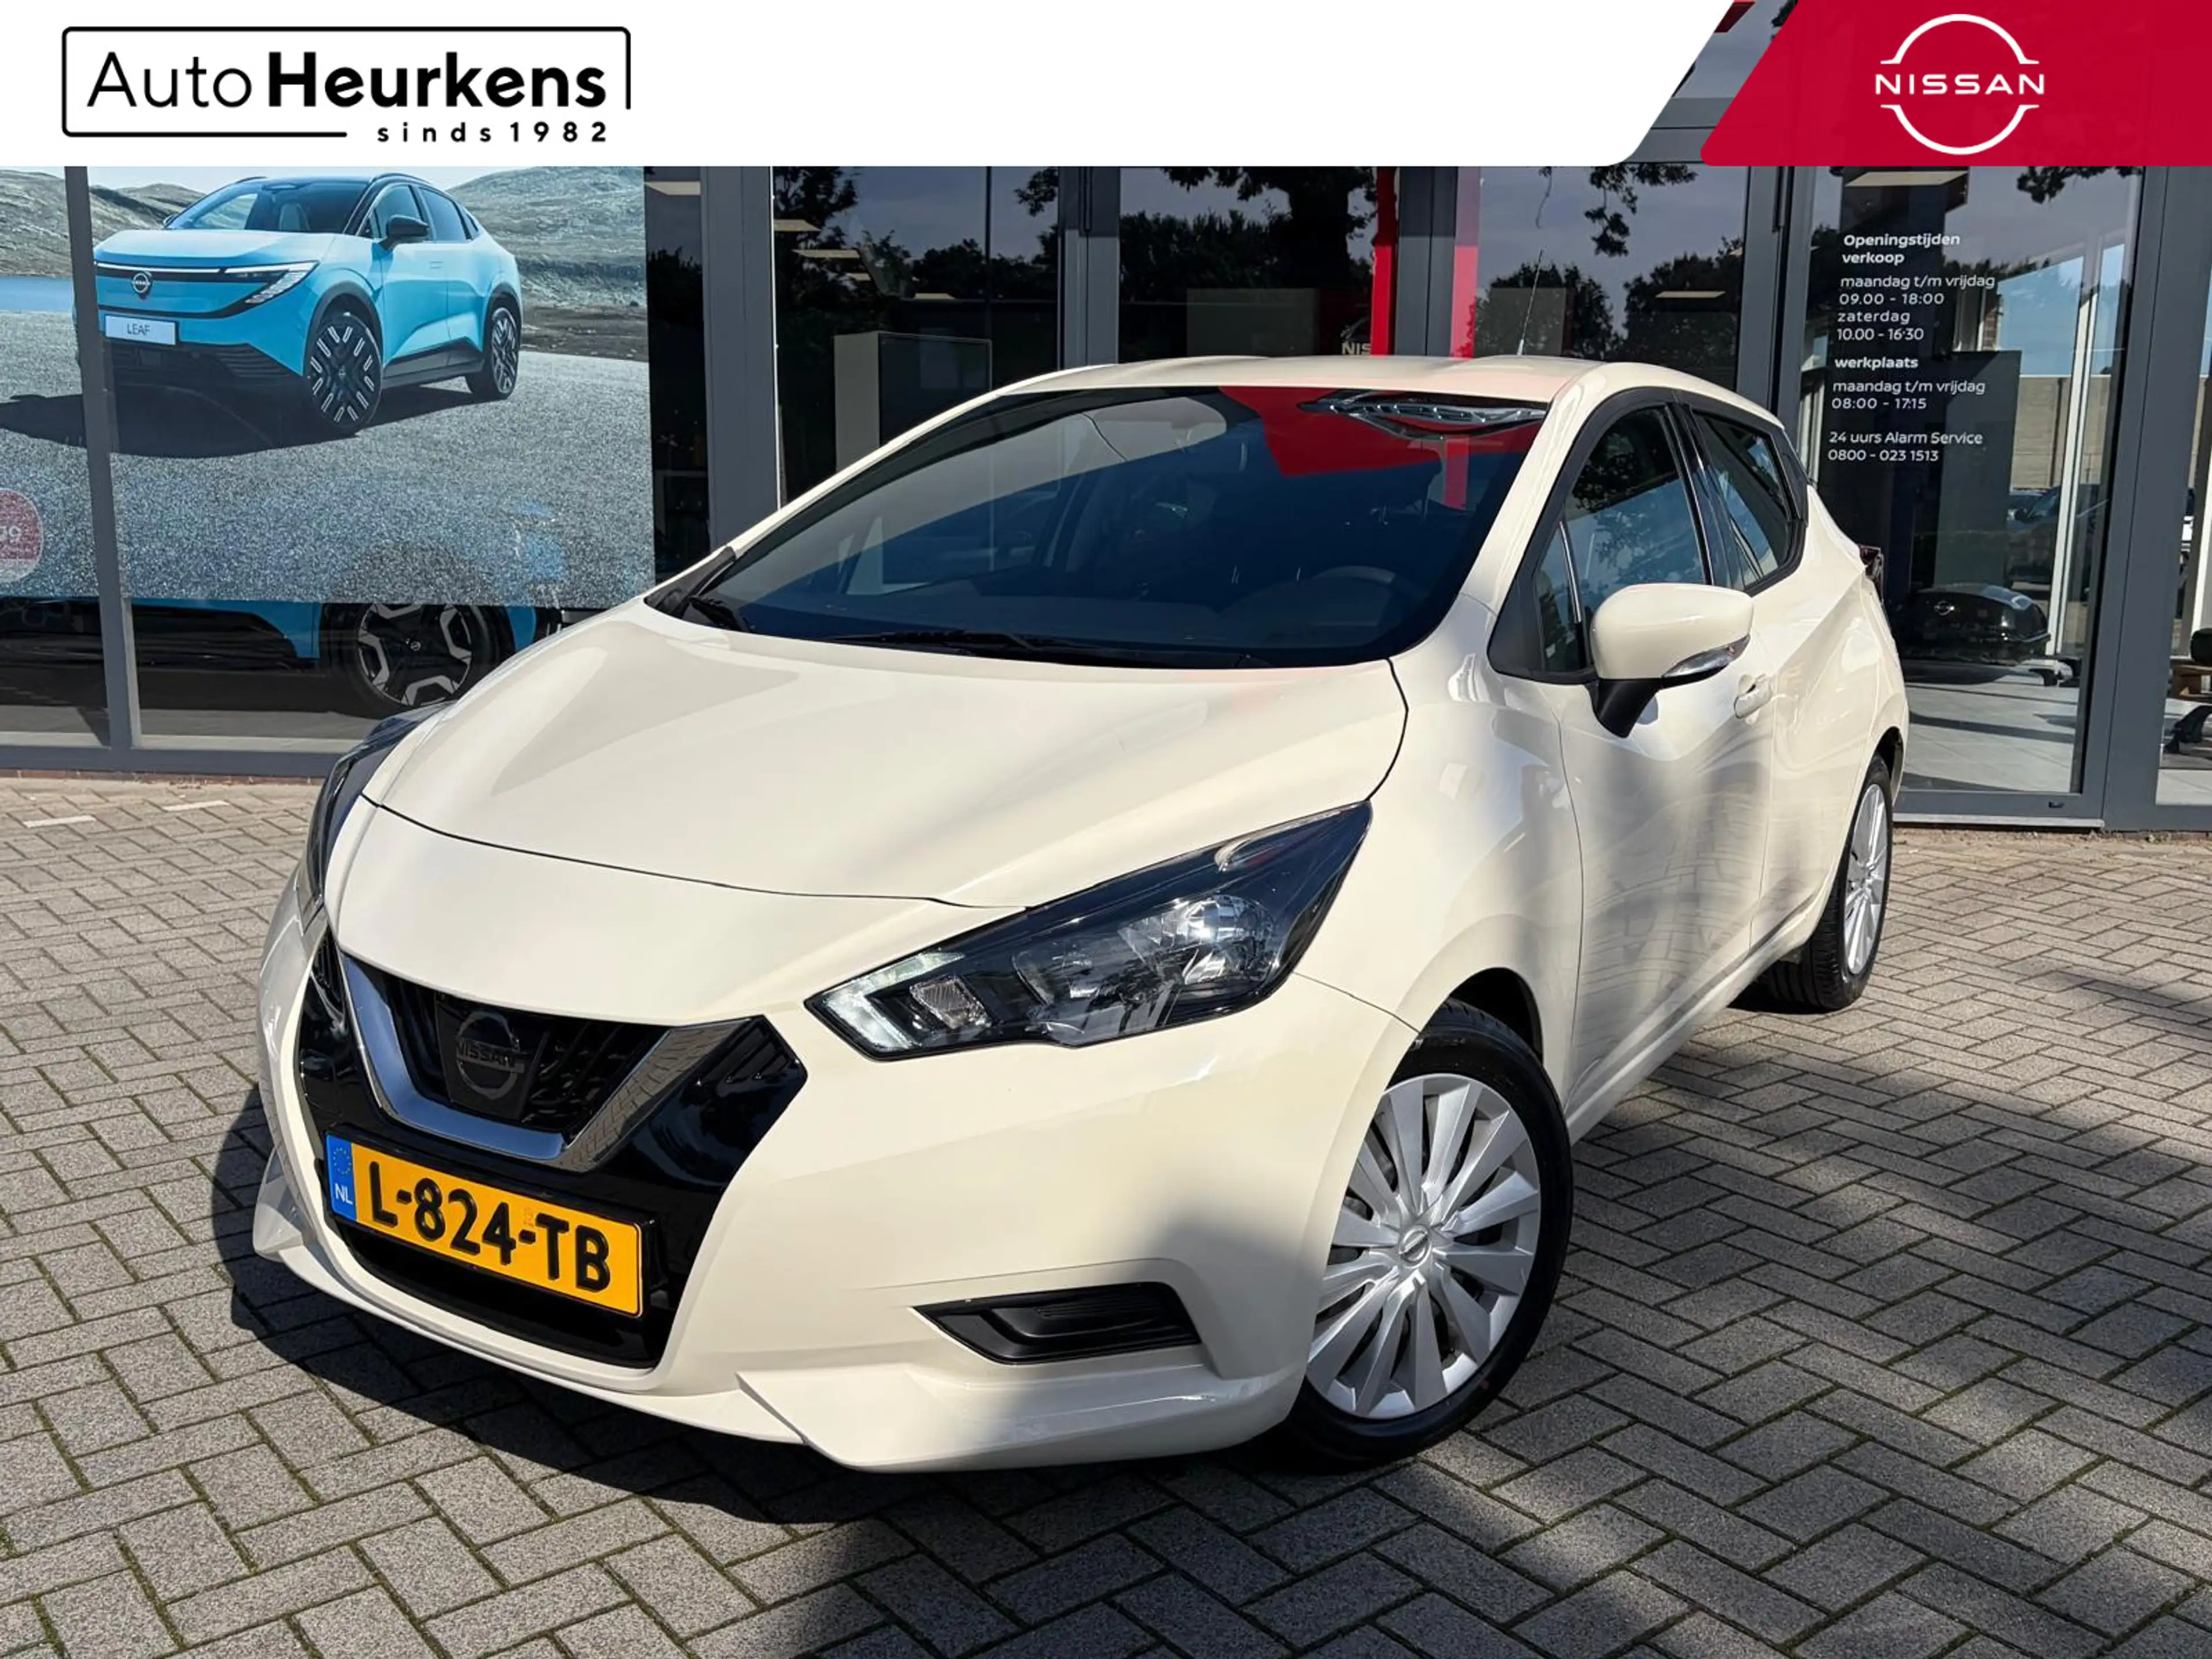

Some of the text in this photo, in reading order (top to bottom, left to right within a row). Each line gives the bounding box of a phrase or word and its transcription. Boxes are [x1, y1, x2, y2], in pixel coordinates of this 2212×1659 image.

[1844, 234, 1960, 248] Openingstijden
[1842, 252, 1904, 265] verkoop
[1840, 274, 1995, 290] maandag t/m vrijdag
[1839, 293, 1884, 305] 09.00
[1902, 293, 1945, 305] 18:00
[1837, 310, 1911, 325] zaterdag
[127, 323, 151, 336] LEAF
[1836, 328, 1875, 340] 10.00
[1834, 357, 1919, 370] werkplaats
[1833, 380, 1986, 395] maandag t/m vrijdag
[1831, 397, 1877, 410] 08:00
[1829, 431, 1983, 445] 24 uurs Alarm Service
[1828, 449, 1867, 461] 0800
[1879, 449, 1907, 461] 023
[1910, 450, 1940, 462] 1513
[457, 1041, 516, 1068] NISSAN
[334, 1183, 353, 1205] NL
[369, 1161, 611, 1293] L-824-TB
